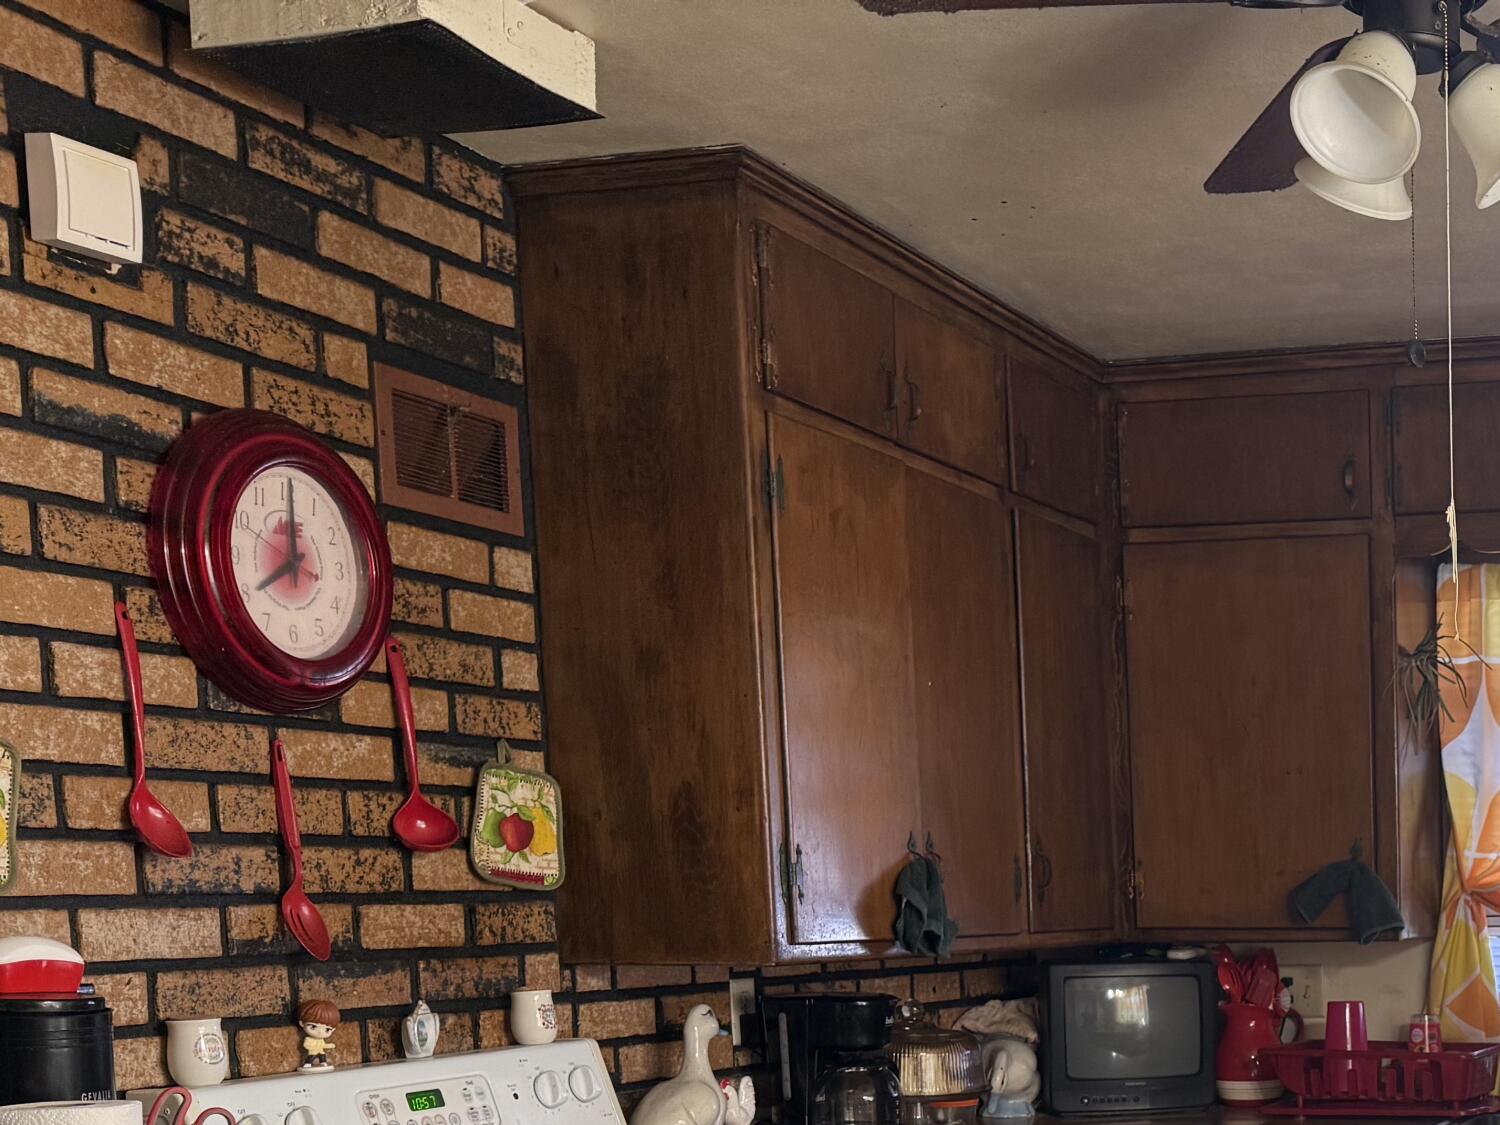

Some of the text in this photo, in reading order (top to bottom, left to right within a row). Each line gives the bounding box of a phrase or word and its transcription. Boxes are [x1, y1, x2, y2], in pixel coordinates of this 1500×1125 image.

[254, 486, 265, 506] 11
[312, 497, 316, 516] 1
[234, 510, 250, 529] 10
[328, 526, 337, 546] 2
[231, 545, 241, 565] 9
[335, 561, 344, 581] 3
[240, 583, 250, 603] 8
[330, 596, 341, 615] 4
[262, 613, 271, 632] 7
[314, 618, 324, 637] 5
[288, 624, 298, 643] 6
[412, 1095, 437, 1110] 10:57
